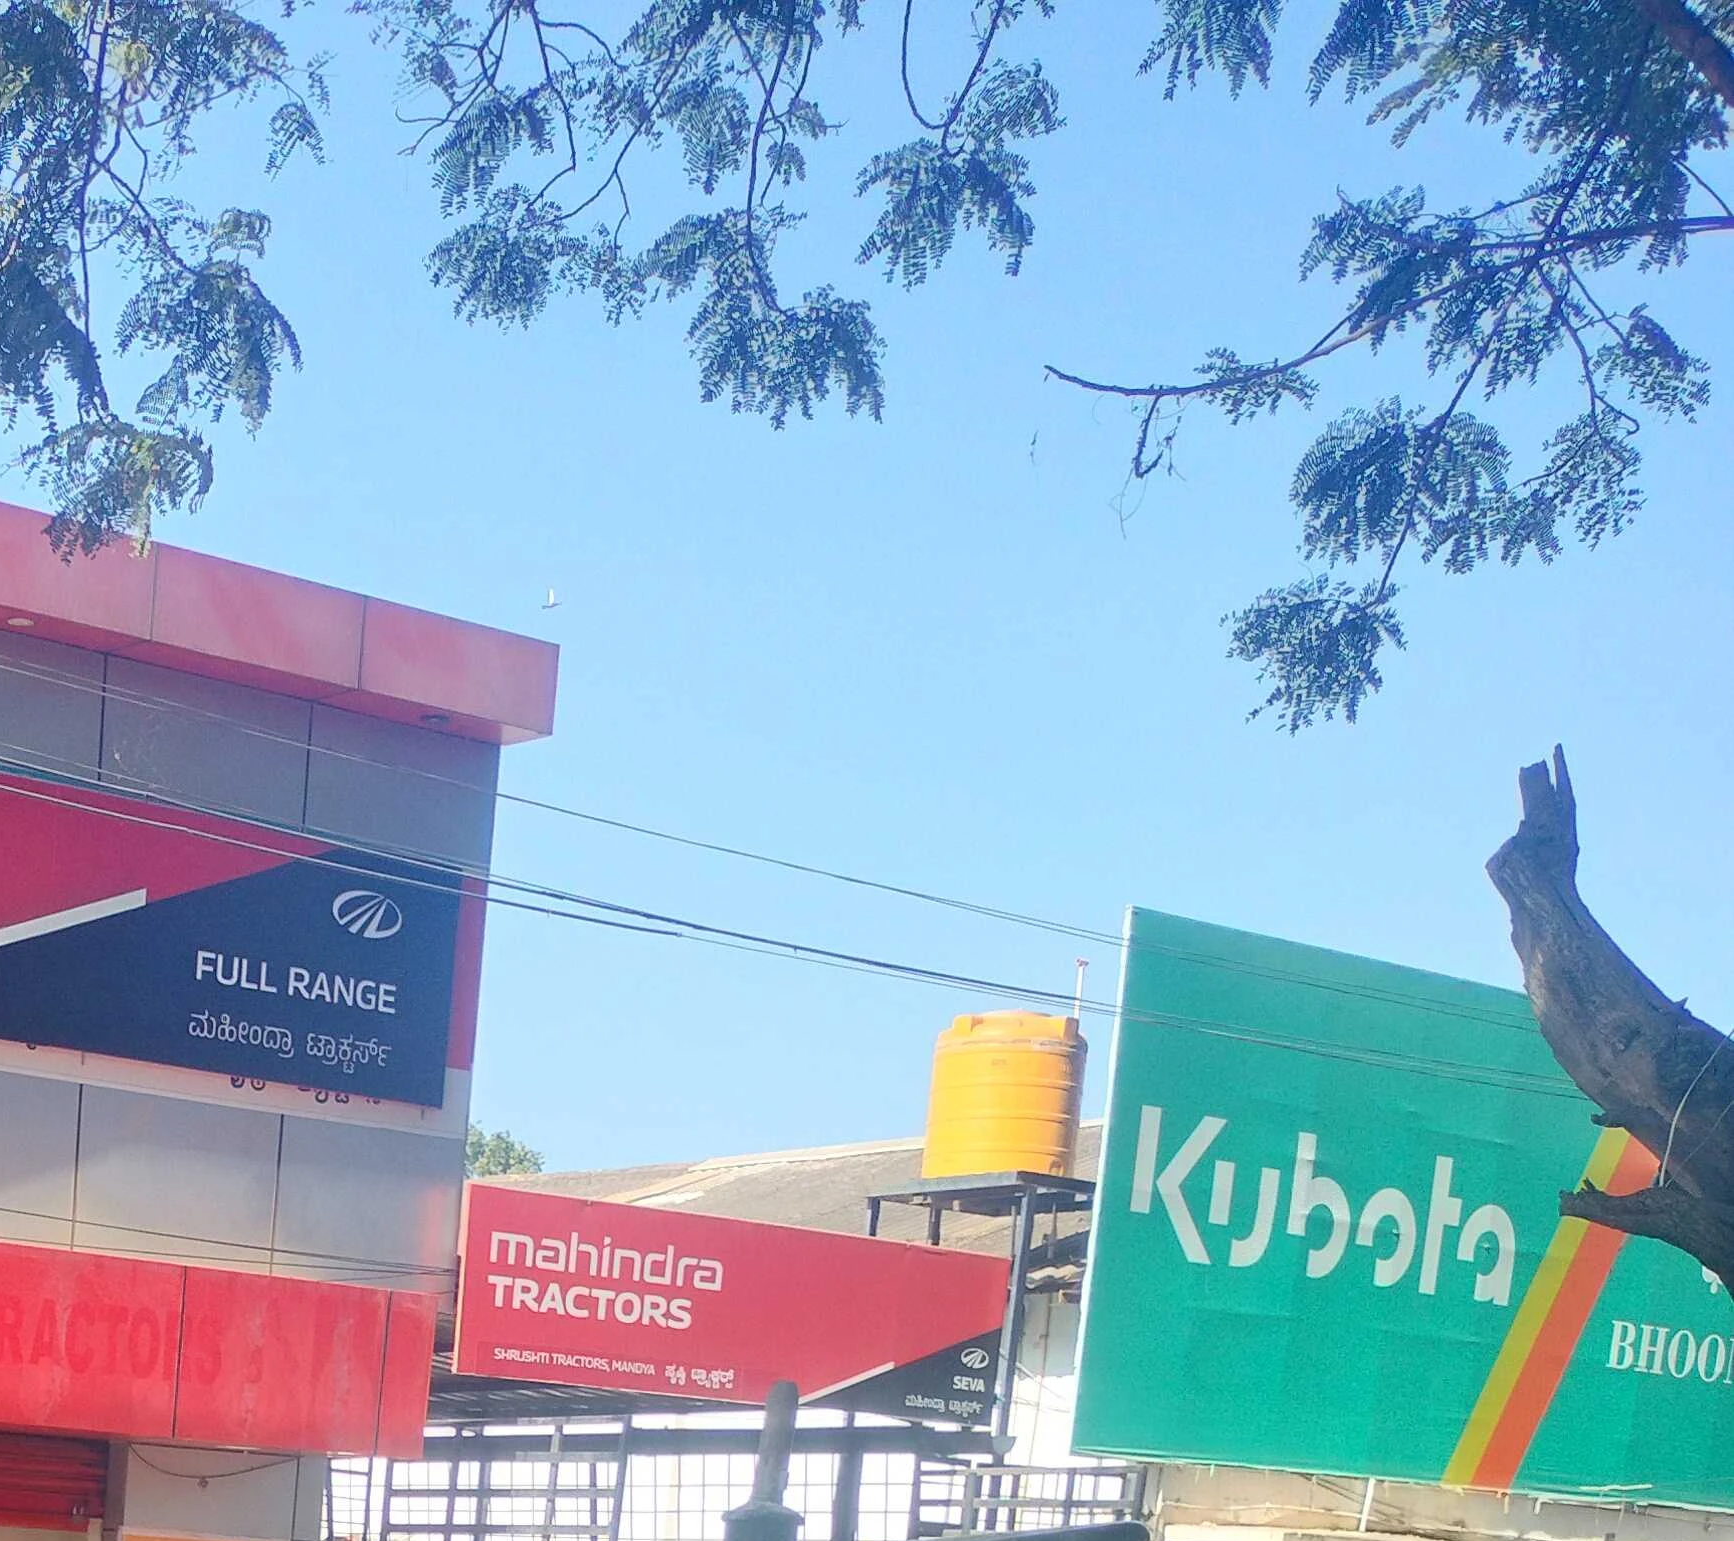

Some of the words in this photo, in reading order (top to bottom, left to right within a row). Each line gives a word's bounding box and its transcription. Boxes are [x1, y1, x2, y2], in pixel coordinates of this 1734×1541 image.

[195, 950, 277, 994] FULL
[287, 966, 397, 1014] RANGE
[187, 1009, 295, 1059] ಮಹೀಂದ್ರಾ
[1129, 1105, 1515, 1307] Kubota
[489, 1231, 724, 1293] mahindra
[487, 1275, 693, 1331] TRACTORS
[493, 1347, 549, 1365] SHRUSHTI
[551, 1353, 611, 1373] TRACTORS,
[612, 1359, 656, 1376] MANDYA
[952, 1375, 986, 1393] SEVA
